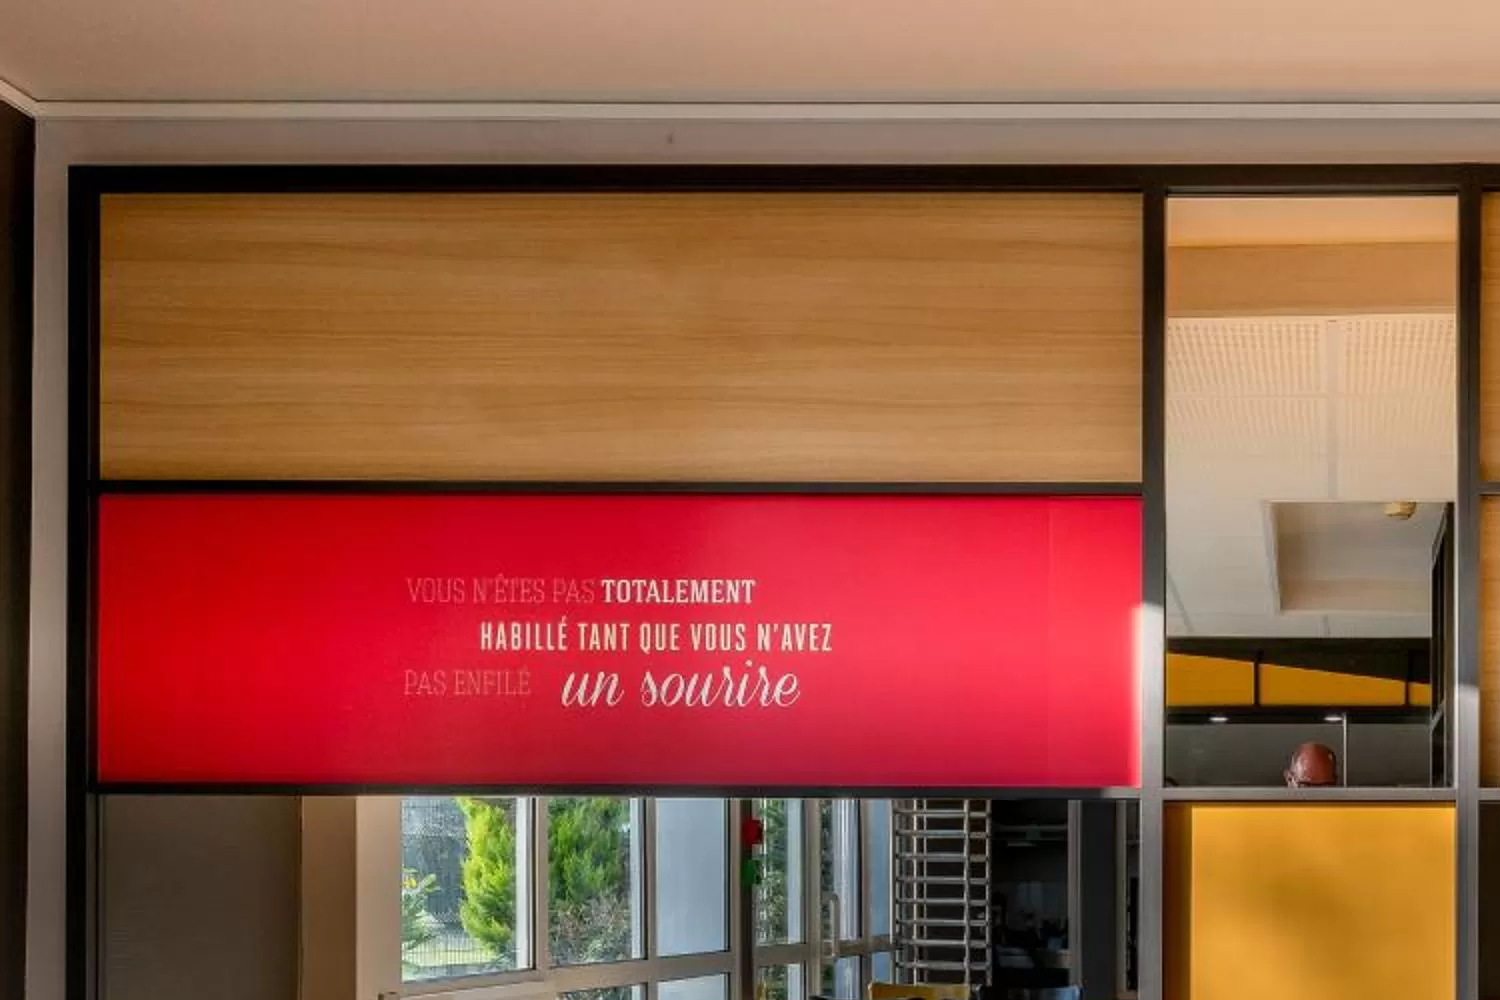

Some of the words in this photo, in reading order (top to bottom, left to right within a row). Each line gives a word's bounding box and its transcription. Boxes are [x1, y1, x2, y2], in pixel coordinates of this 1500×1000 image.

[405, 577, 466, 604] VOUS
[552, 577, 596, 604] PAS
[601, 578, 757, 604] TOTALEMENT
[480, 615, 568, 651] HABILLÉ
[577, 623, 631, 652] TANT
[639, 623, 680, 654] QUE
[690, 623, 747, 652] VOUS
[756, 623, 833, 652] N'AVEZ
[404, 669, 447, 696] PAS
[453, 664, 532, 696] ENFILÉ
[561, 671, 625, 707] un
[639, 659, 801, 708] sourire
